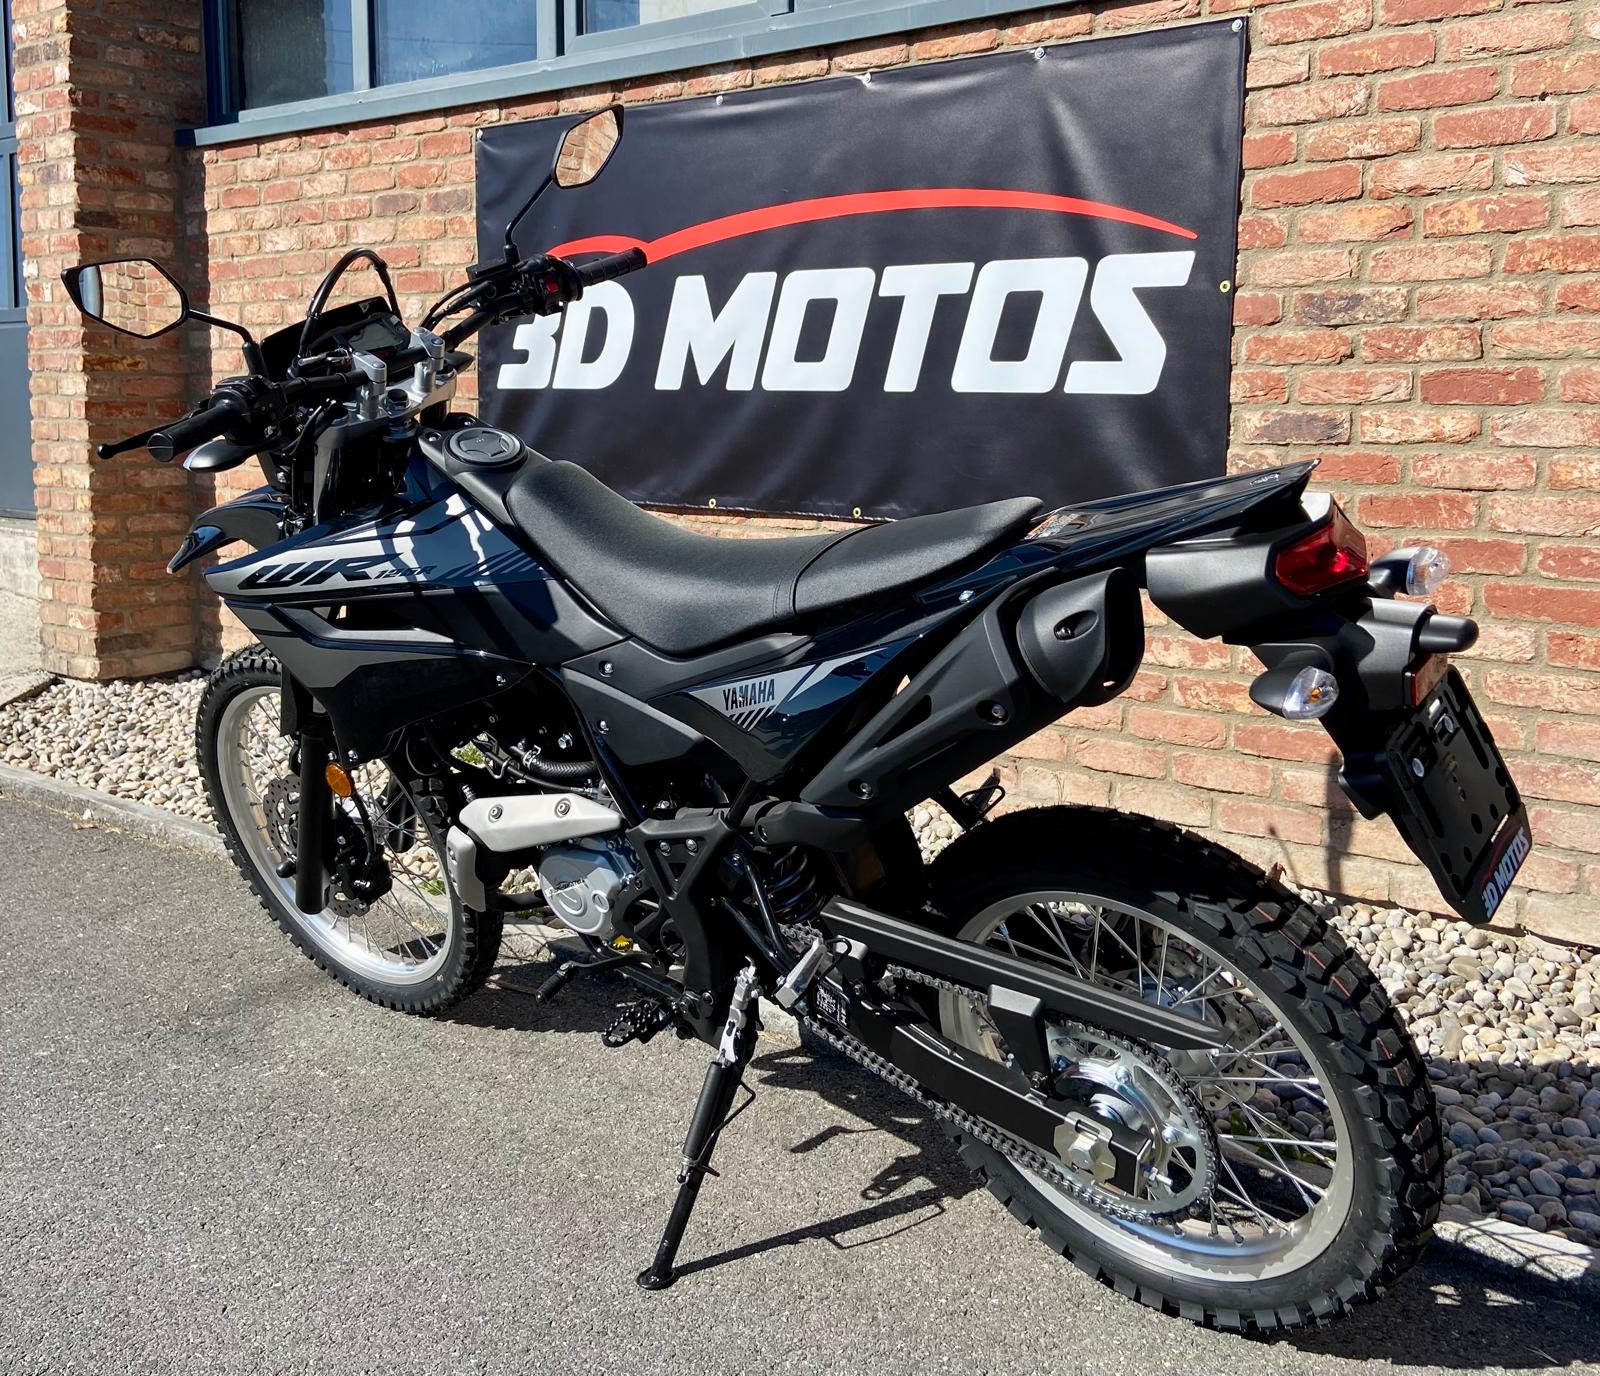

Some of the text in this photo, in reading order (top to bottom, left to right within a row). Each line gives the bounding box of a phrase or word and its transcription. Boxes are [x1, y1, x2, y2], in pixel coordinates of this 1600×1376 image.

[497, 251, 1196, 394] 3D MOTOS
[722, 678, 775, 711] YAMAHA
[1481, 825, 1530, 919] 3D MOTOS
